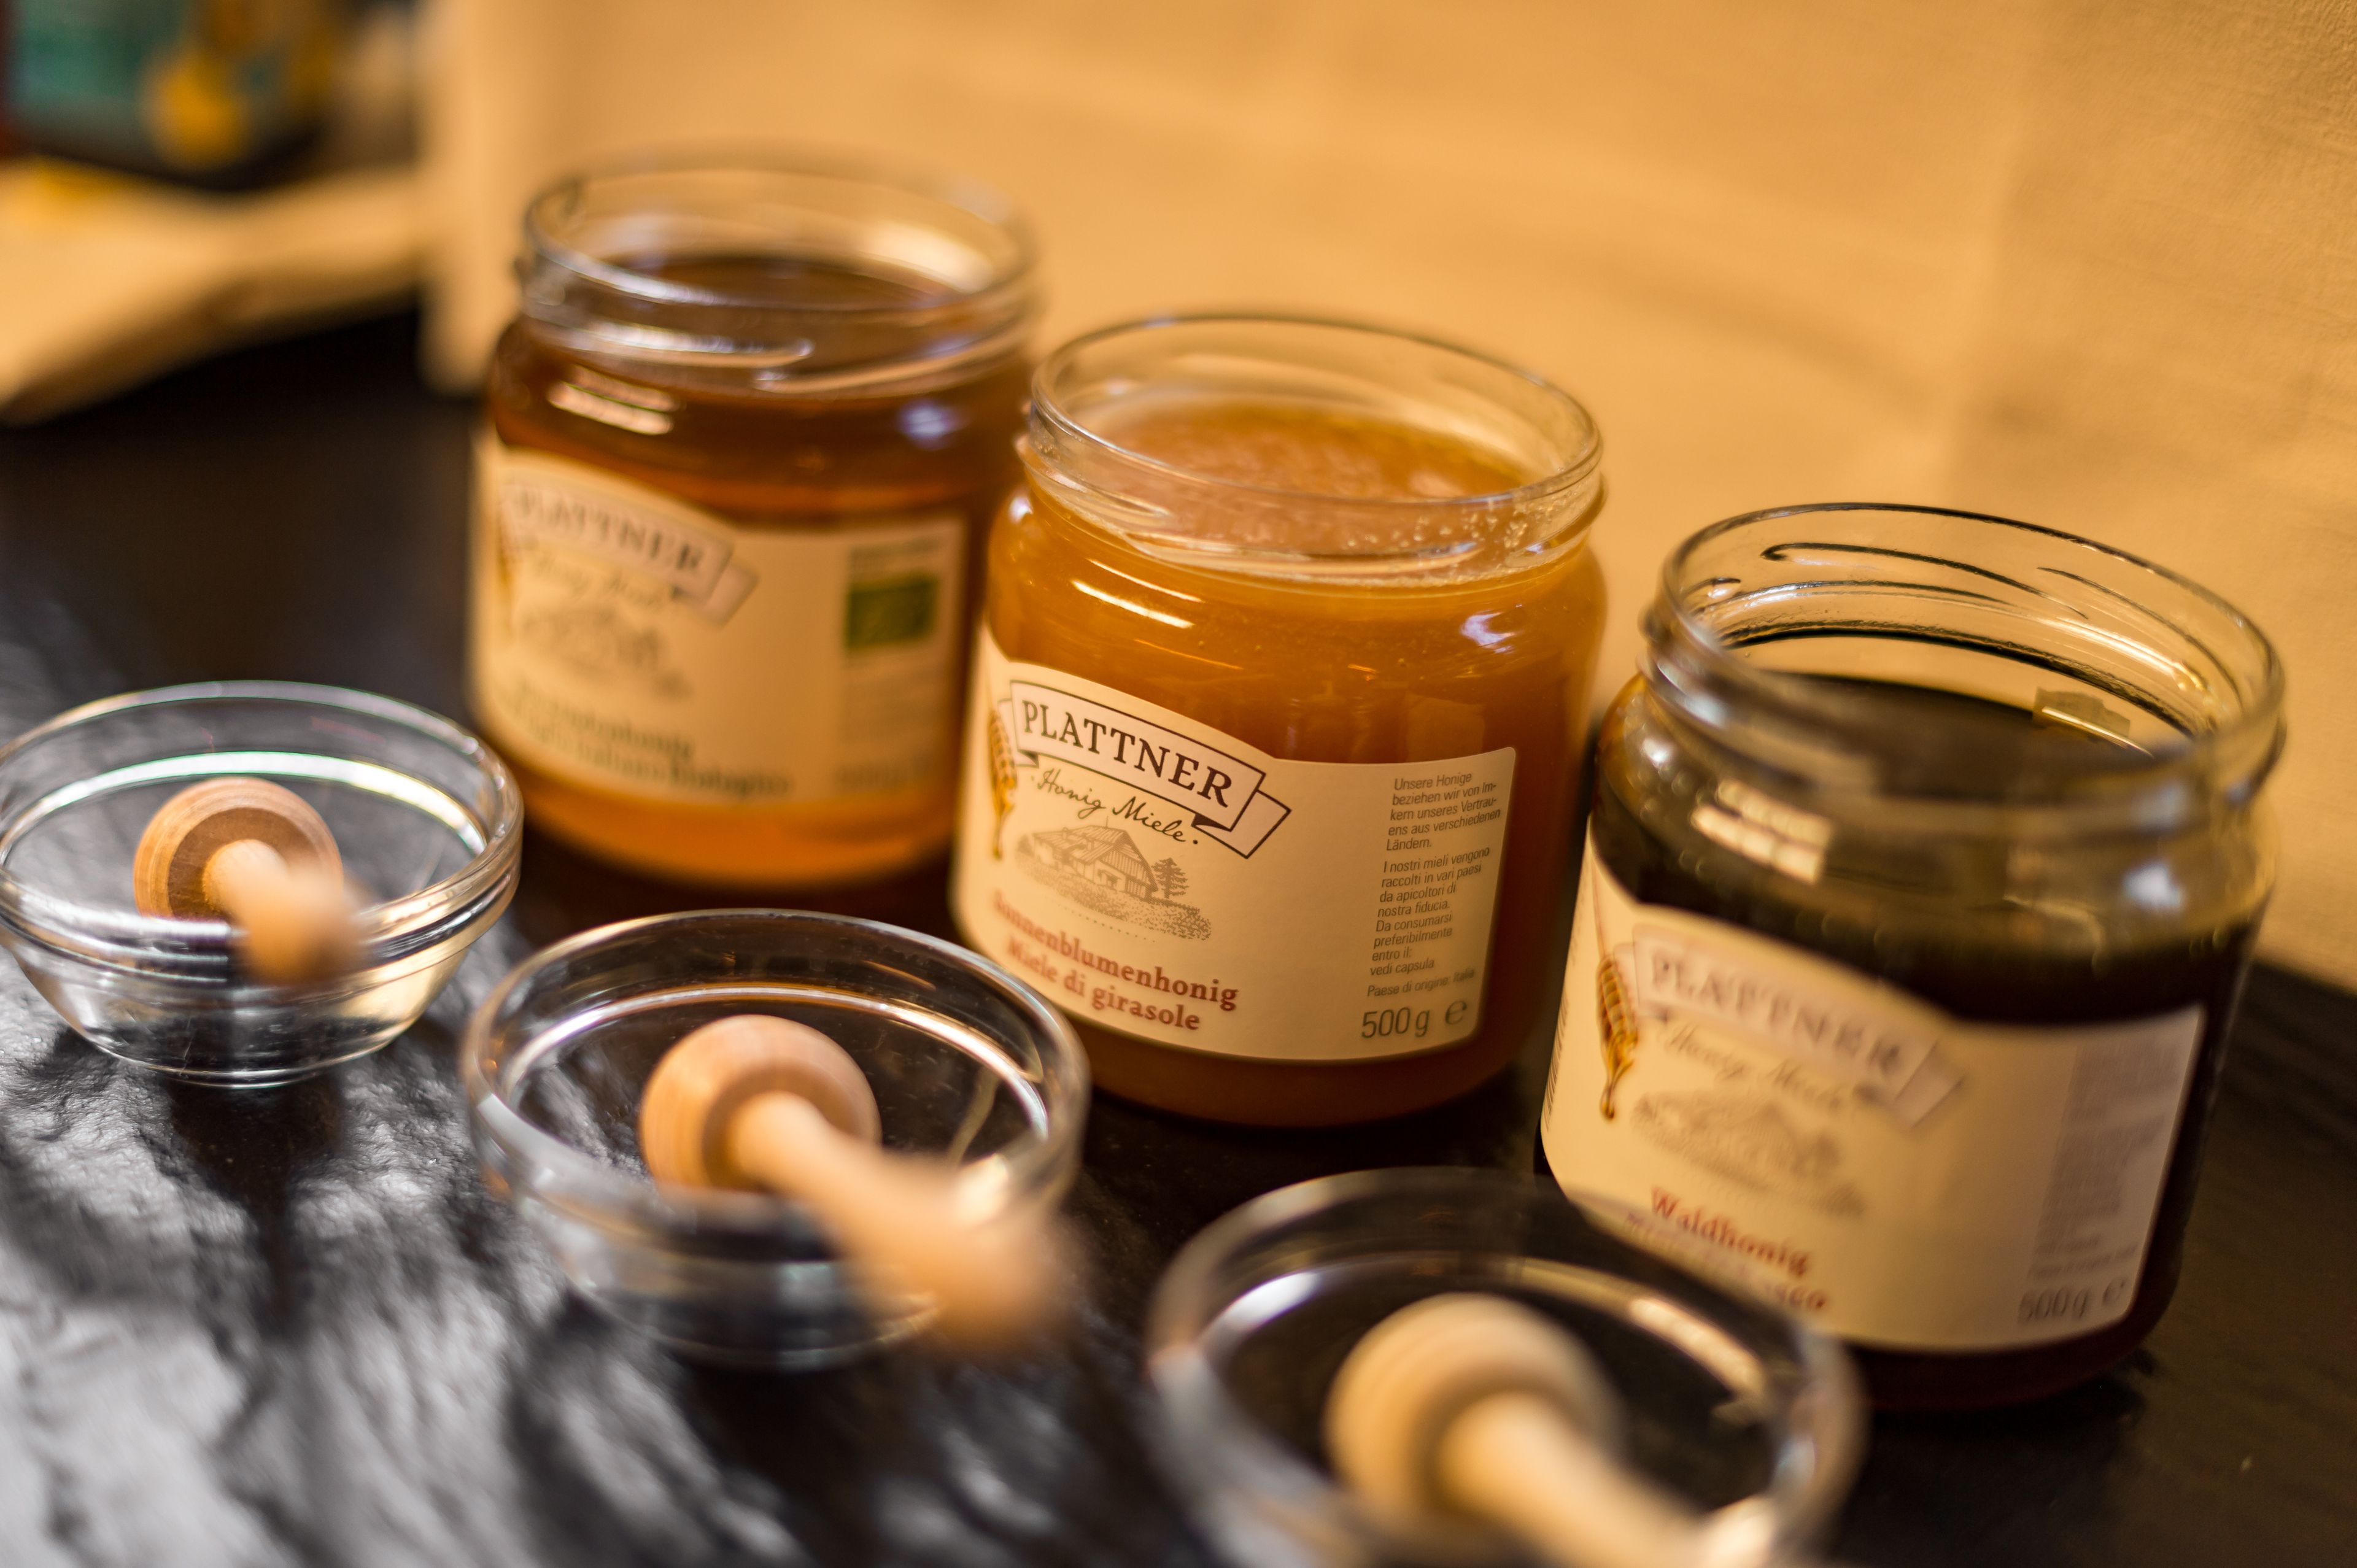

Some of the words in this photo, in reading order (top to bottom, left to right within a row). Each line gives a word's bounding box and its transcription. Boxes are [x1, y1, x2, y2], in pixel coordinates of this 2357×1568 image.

[1021, 700, 1233, 808] PLATTNER
[1394, 778, 1433, 791] Unsere
[1436, 771, 1473, 787] Honige
[1037, 767, 1107, 820] Honig
[1112, 795, 1186, 843] Miele
[1392, 793, 1441, 806] beziehen
[1444, 787, 1460, 801] wir
[1463, 786, 1479, 798] von
[1482, 781, 1497, 794] Im-
[1390, 808, 1414, 821] kern
[1417, 804, 1458, 819] unseres
[1461, 797, 1497, 813] Vertrau-
[1388, 825, 1408, 836] ens
[1411, 823, 1430, 835] aus
[1433, 808, 1501, 832] verschiedenen
[1386, 838, 1432, 851] Ländern.
[1390, 859, 1420, 873] nostri
[1423, 854, 1449, 870] mieli
[1452, 846, 1490, 865] vengono
[1381, 873, 1421, 888] raccolti
[1424, 872, 1434, 884] in
[1436, 869, 1455, 882] vari
[1456, 862, 1482, 881] paesi
[1379, 890, 1393, 903] da
[1397, 884, 1445, 905] apicoltori
[1447, 881, 1457, 894] di
[1377, 904, 1412, 918] nostra
[1415, 900, 1450, 914] fiducia.
[1376, 920, 1391, 933] Da
[1394, 910, 1453, 931] consumarsi
[991, 887, 1239, 1012] Sonnenblumenhonig
[1373, 927, 1453, 950] preferibilmente
[1369, 962, 1392, 976] vedi
[1395, 957, 1435, 975] capsula
[1371, 949, 1400, 962] entro
[1007, 934, 1059, 983] Miele
[1064, 968, 1086, 997] di
[1092, 985, 1201, 1031] girasole
[1367, 984, 1400, 997] Paese
[1402, 981, 1412, 993] di
[1651, 951, 1903, 1078] PLATTNER
[1651, 1186, 1812, 1279] Waldhonig
